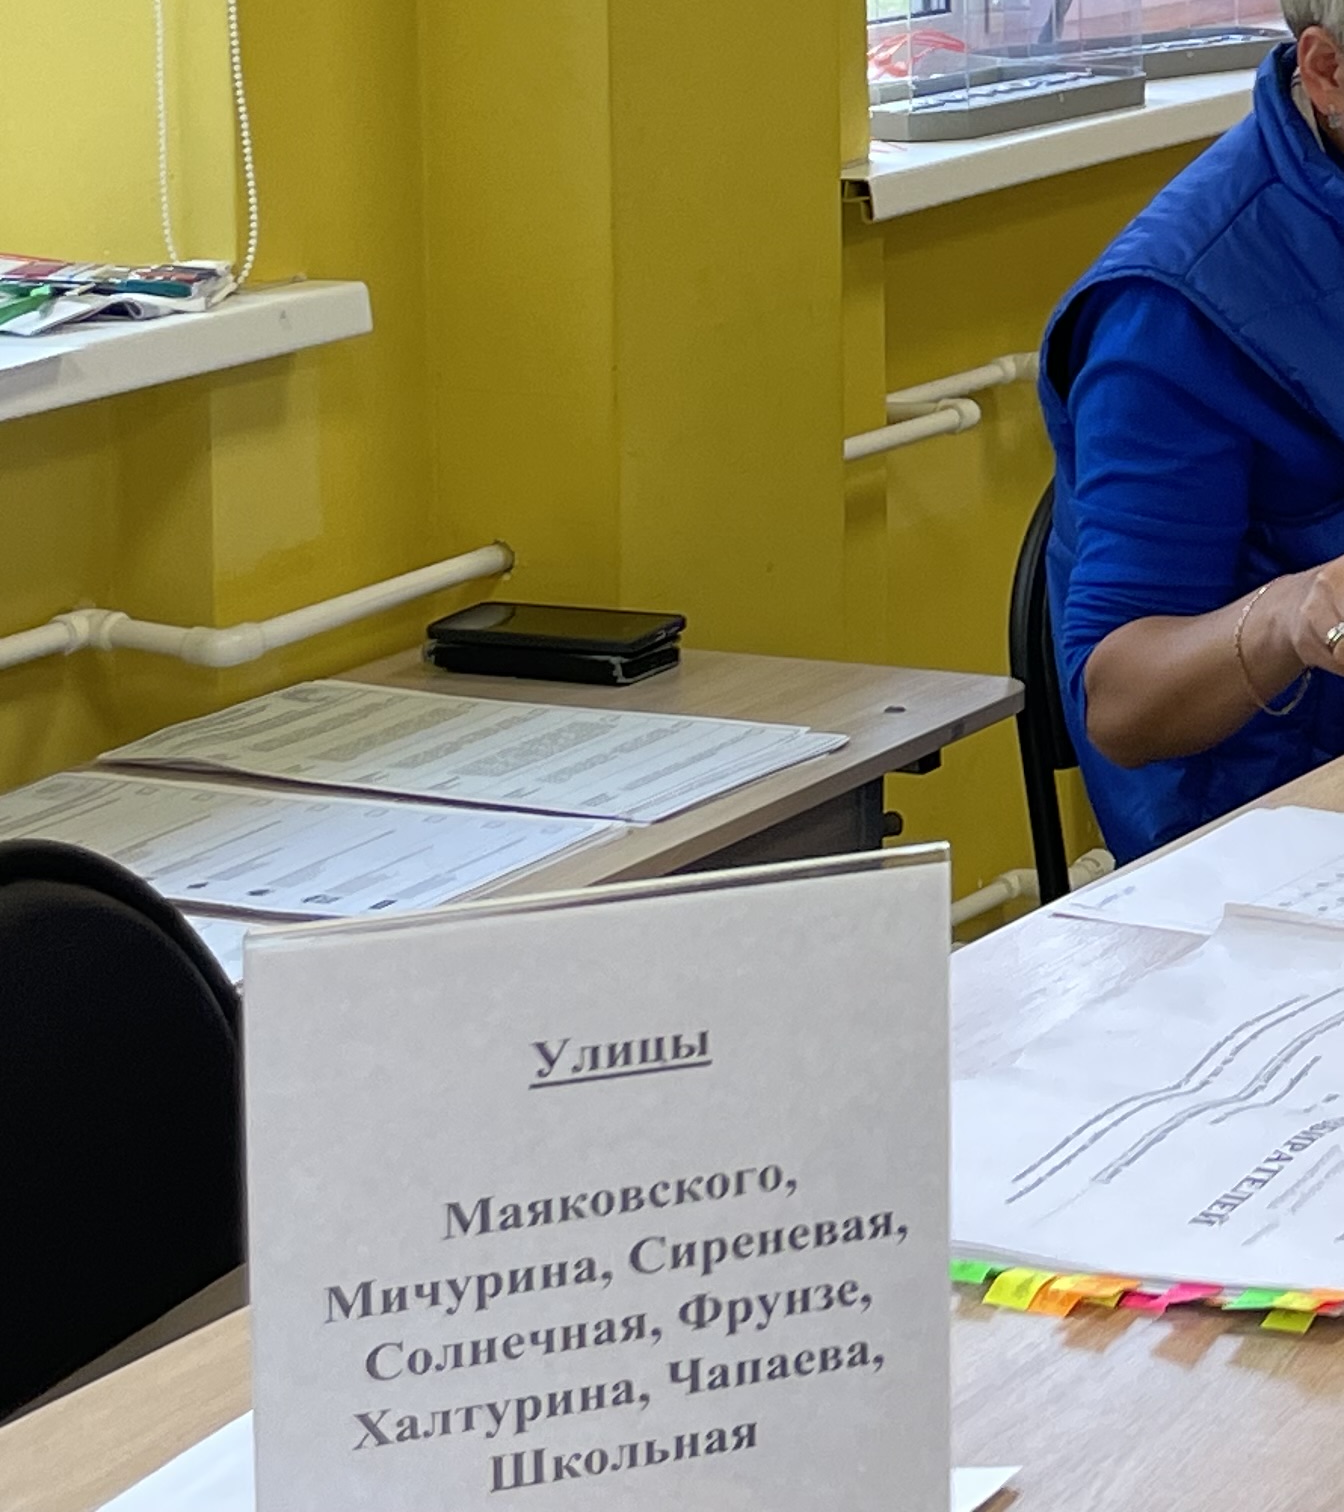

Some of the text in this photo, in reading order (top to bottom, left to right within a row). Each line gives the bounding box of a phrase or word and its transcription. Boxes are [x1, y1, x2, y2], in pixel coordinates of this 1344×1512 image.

[528, 1030, 713, 1090] Улицы
[443, 1165, 797, 1241] Маяковского,
[324, 1211, 908, 1324] Мичурина, Сиреневая,
[365, 1280, 872, 1381] Солнечная, Фрунзе,
[353, 1341, 885, 1451] Халтурина, Чапаева,
[490, 1421, 758, 1494] Школьная
